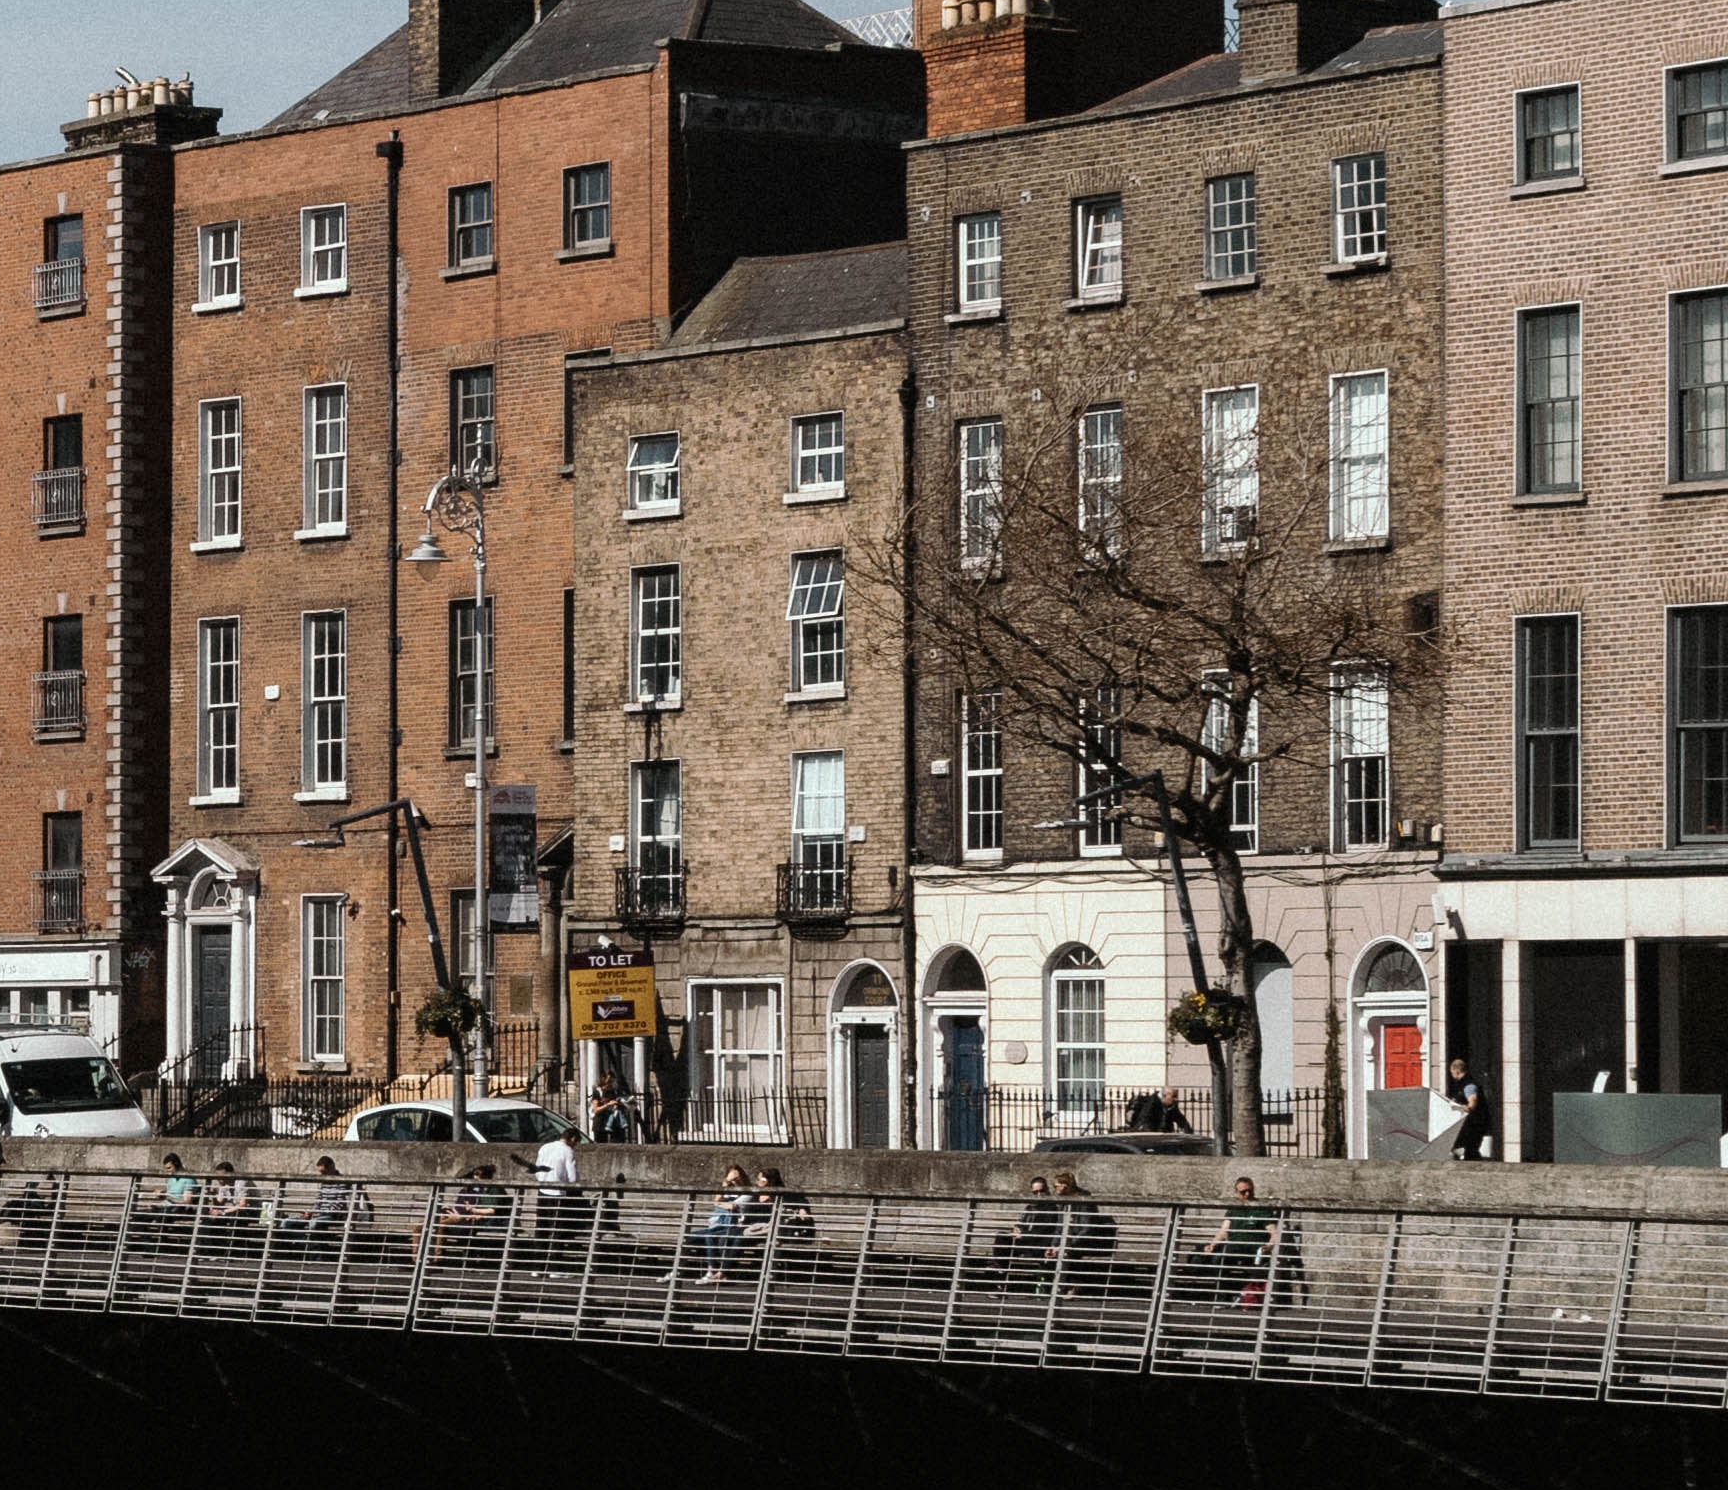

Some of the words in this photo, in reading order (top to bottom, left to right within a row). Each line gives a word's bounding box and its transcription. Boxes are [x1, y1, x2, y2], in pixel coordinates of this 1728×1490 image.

[588, 955, 606, 966] TO
[610, 954, 633, 965] LET
[596, 970, 627, 979] OFFICE
